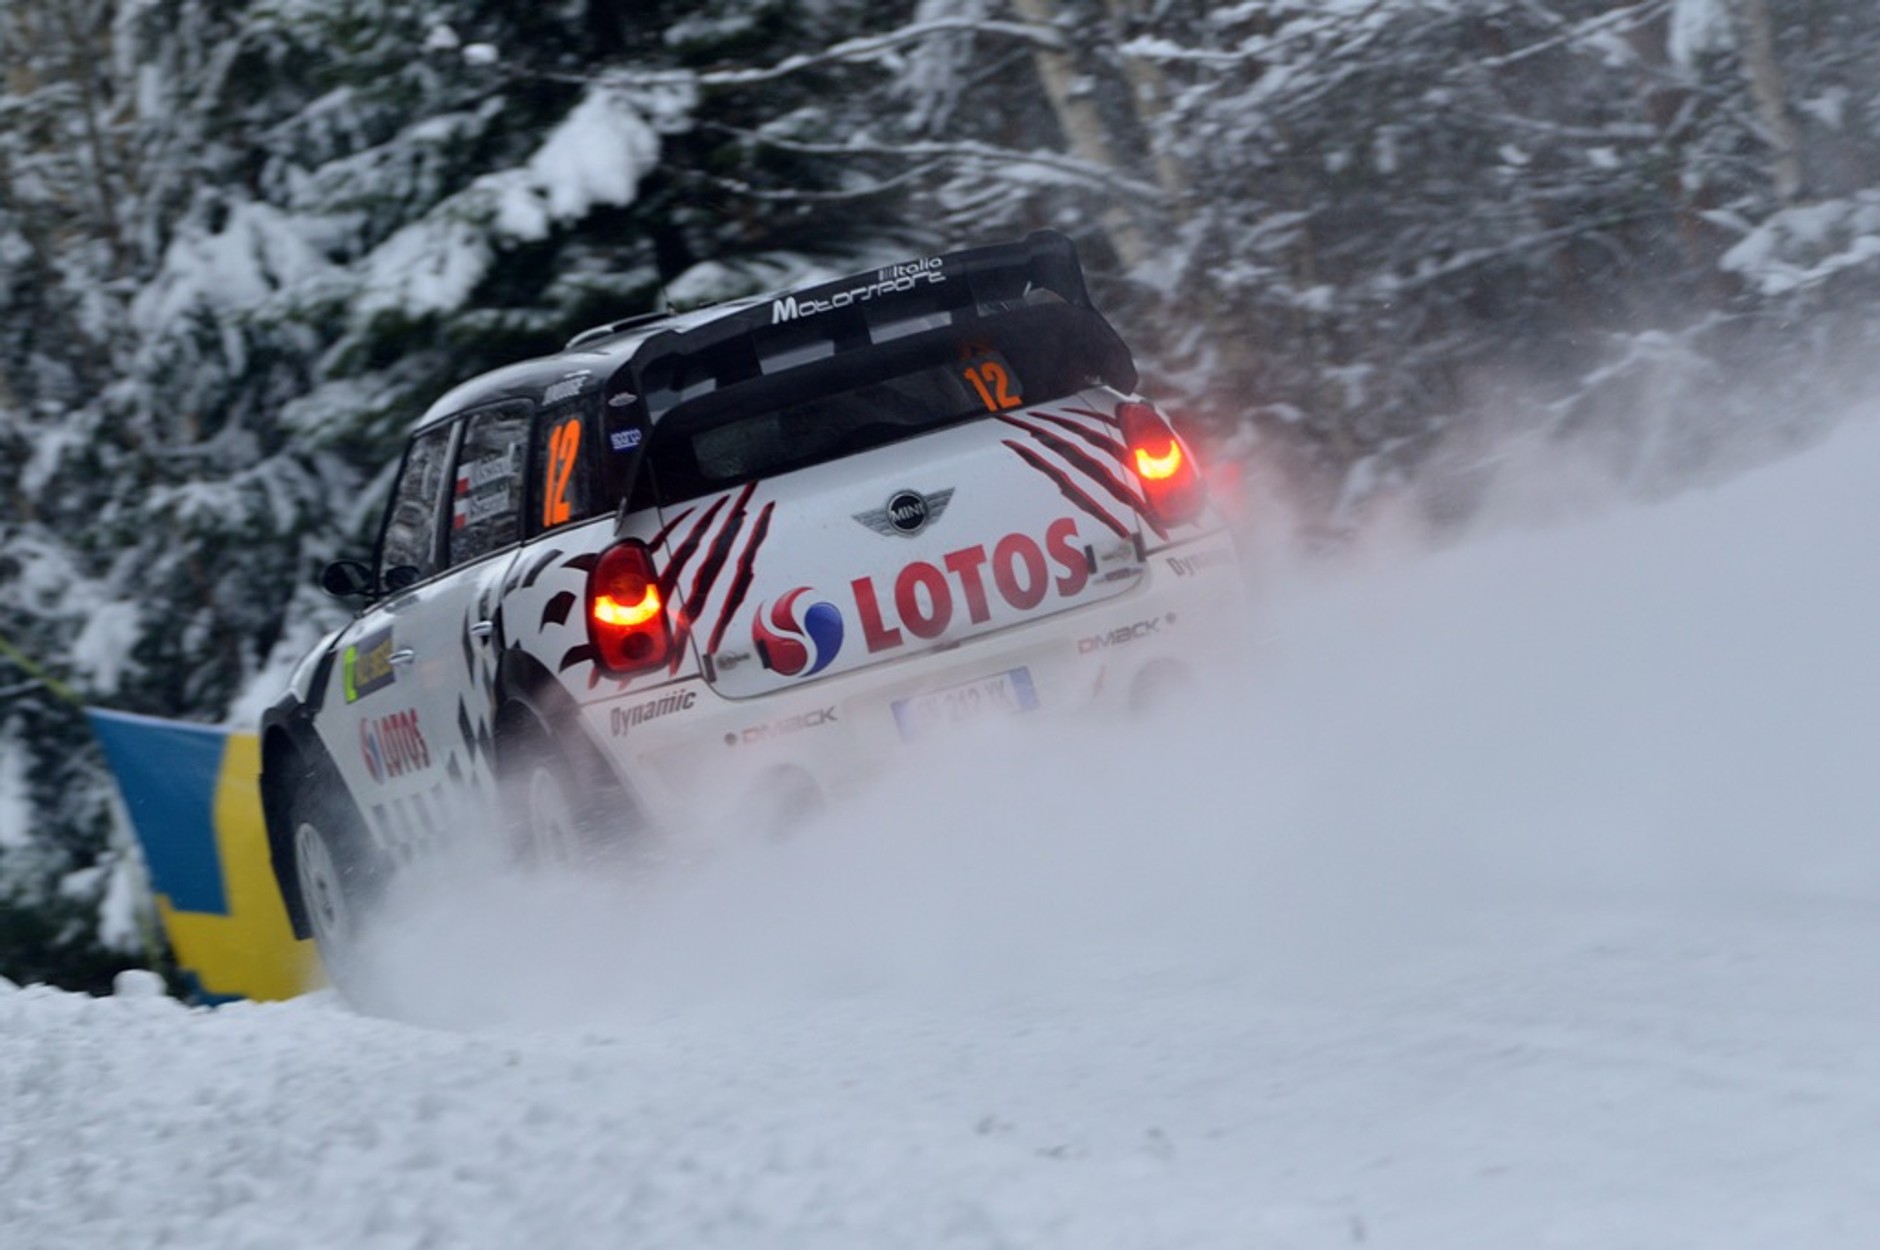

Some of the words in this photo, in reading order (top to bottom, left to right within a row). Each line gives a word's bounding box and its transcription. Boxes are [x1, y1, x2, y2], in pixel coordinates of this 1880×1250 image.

[771, 271, 946, 324] Motorsport
[963, 361, 1023, 413] 12
[543, 418, 582, 527] 12
[890, 503, 925, 522] MINI
[851, 517, 1089, 654] LOTOS
[610, 688, 697, 737] Dynamic
